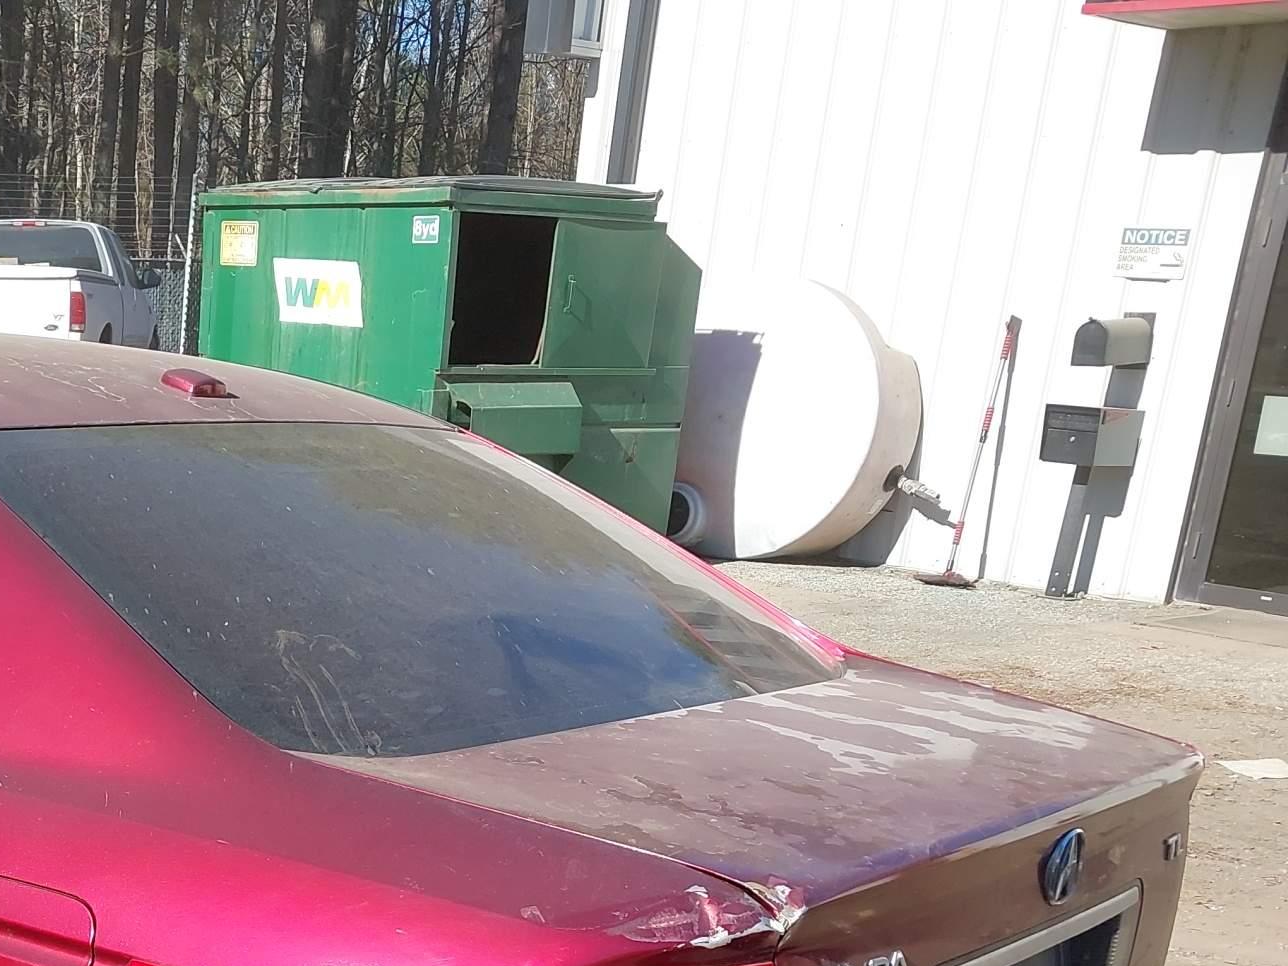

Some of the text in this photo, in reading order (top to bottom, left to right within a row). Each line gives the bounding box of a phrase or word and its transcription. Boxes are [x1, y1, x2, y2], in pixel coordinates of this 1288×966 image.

[1124, 230, 1187, 244] NOTICE
[1119, 246, 1161, 255] DESIGNATED
[284, 276, 351, 309] WM
